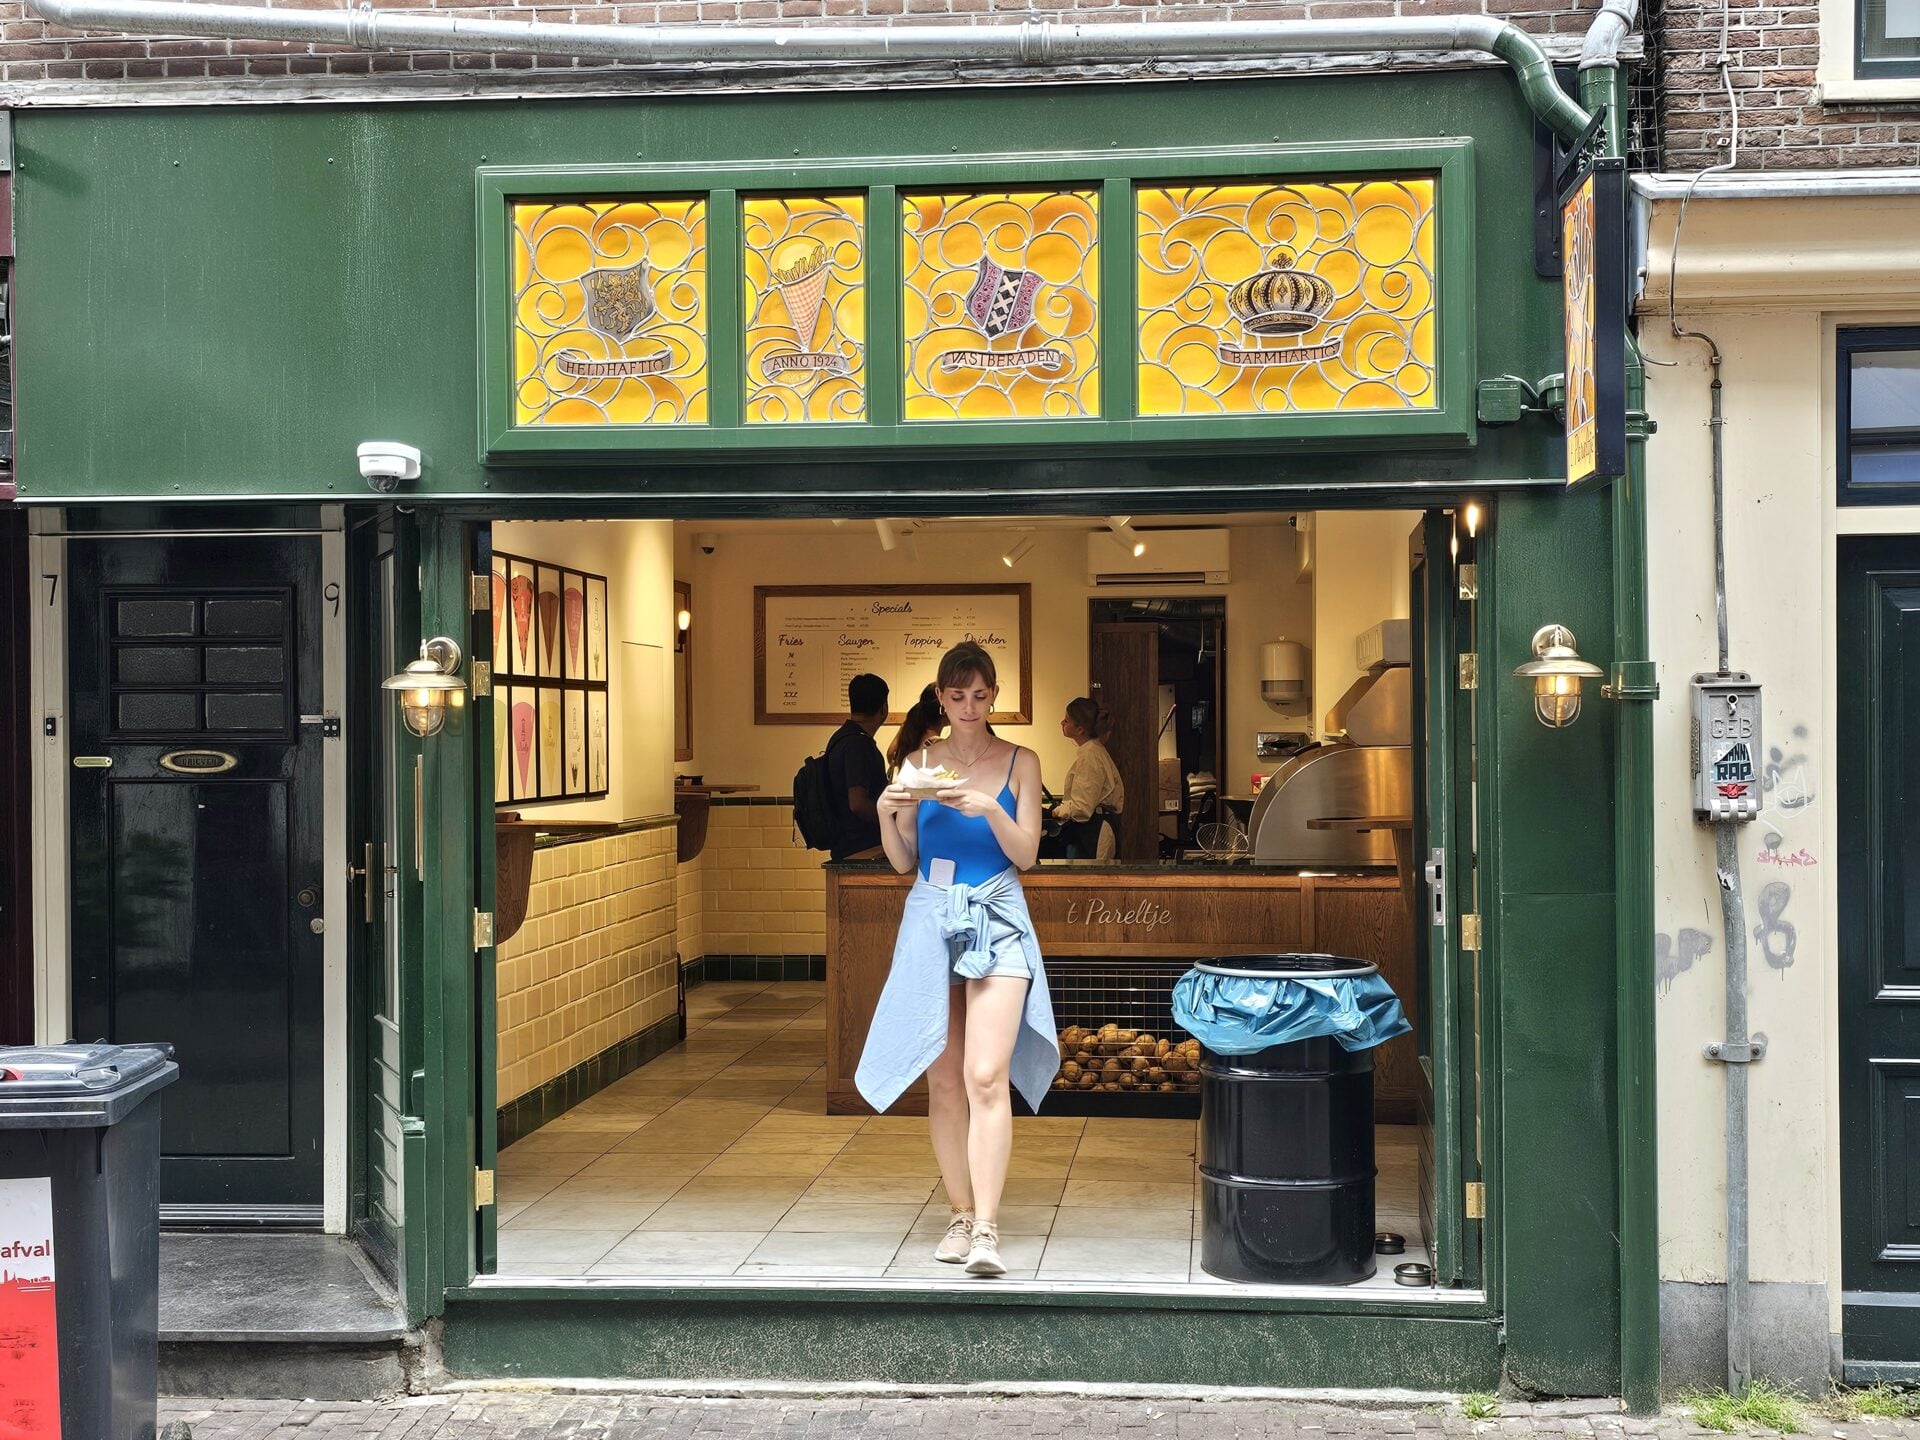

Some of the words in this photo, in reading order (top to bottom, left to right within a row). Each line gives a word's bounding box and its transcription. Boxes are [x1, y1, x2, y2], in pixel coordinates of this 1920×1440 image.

[772, 356, 809, 370] ANNO
[814, 356, 837, 367] 1924
[952, 350, 1055, 367] VASTBERADEN
[1231, 345, 1336, 364] BARMHARTIG
[565, 358, 664, 376] HELDHAFTIG
[41, 574, 58, 606] 7
[324, 583, 340, 618] 9
[871, 601, 913, 616] Specials
[778, 634, 804, 647] Fries
[838, 633, 874, 648] Sauzen
[903, 632, 943, 649] Topping
[1711, 718, 1752, 738] GEB
[1716, 761, 1752, 780] RAP
[1085, 898, 1172, 932] Pareltje
